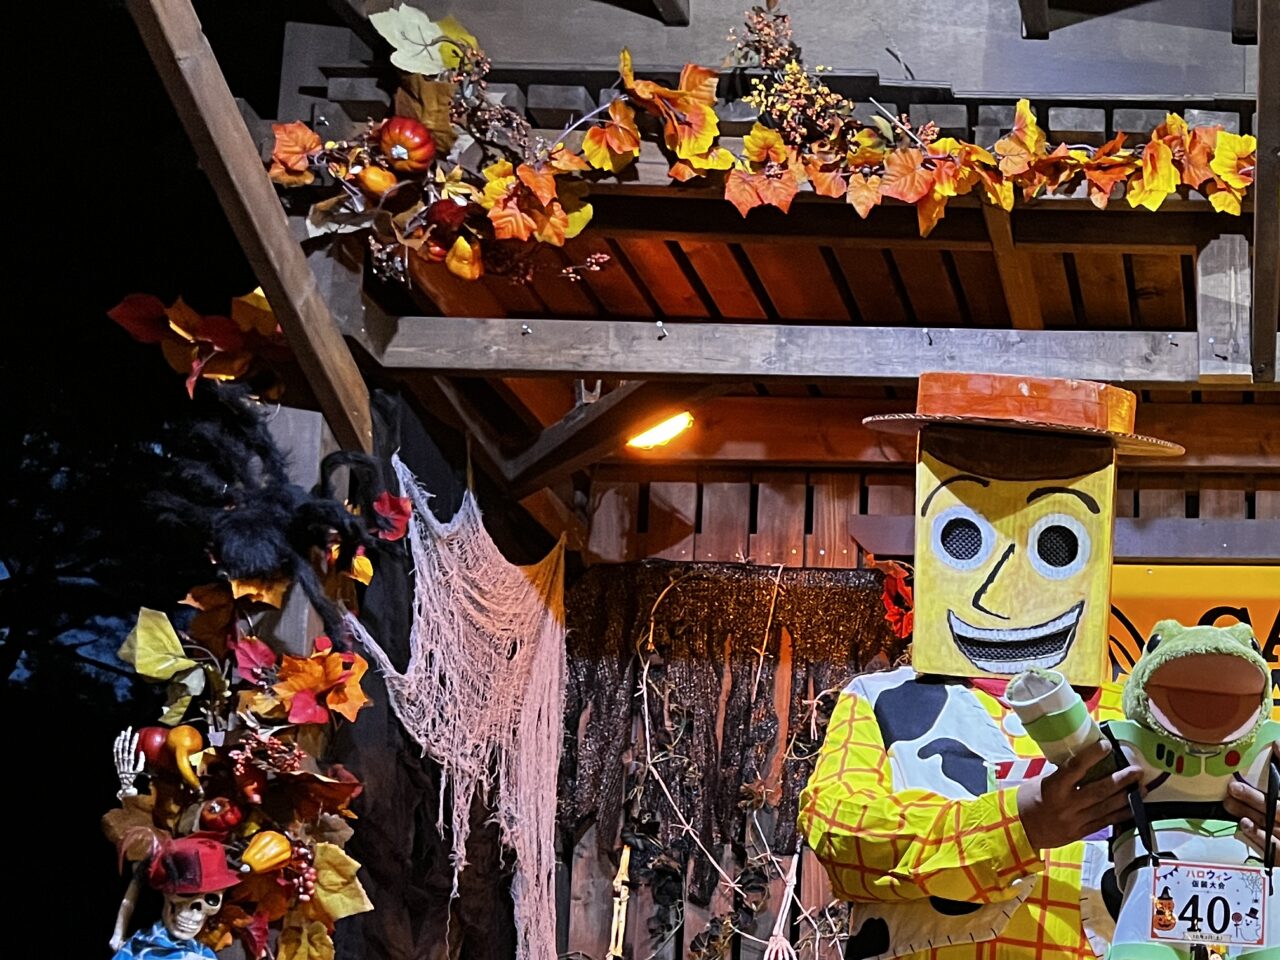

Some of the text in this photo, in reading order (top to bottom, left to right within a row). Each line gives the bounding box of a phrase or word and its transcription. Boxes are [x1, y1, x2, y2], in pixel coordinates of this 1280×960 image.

[1185, 870, 1232, 881] ハロウィン
[1178, 894, 1231, 934] 40
